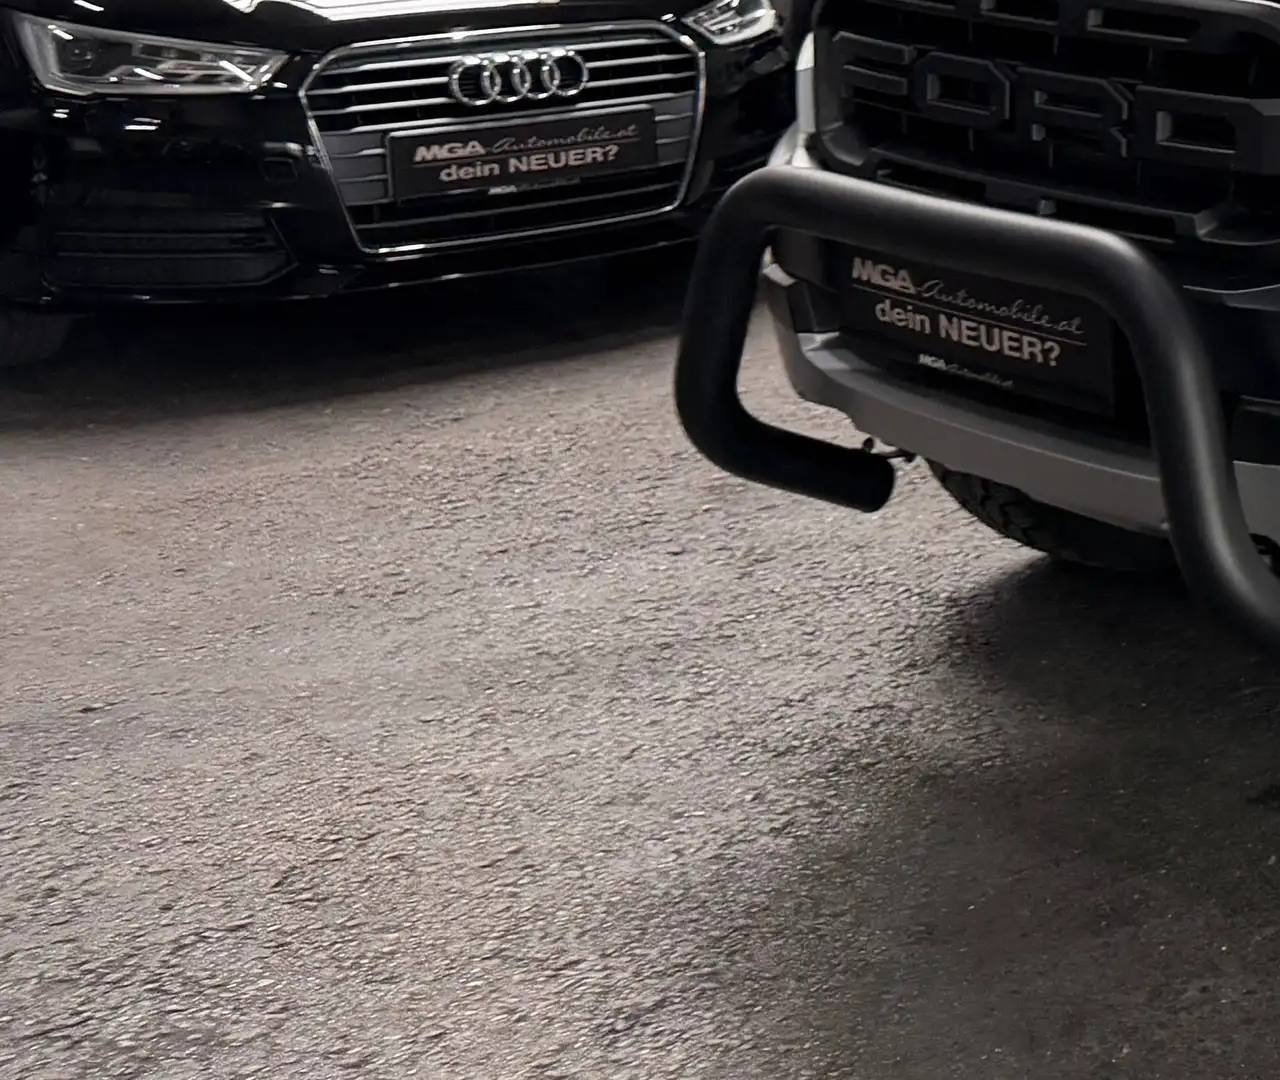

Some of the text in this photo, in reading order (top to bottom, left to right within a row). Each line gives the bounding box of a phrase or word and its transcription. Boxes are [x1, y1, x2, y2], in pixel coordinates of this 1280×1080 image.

[832, 30, 1275, 175] FORD
[412, 139, 487, 163] MGA
[438, 144, 620, 183] dein NEUER?
[852, 256, 917, 295] MGA
[875, 299, 1062, 367] dein NEUER?
